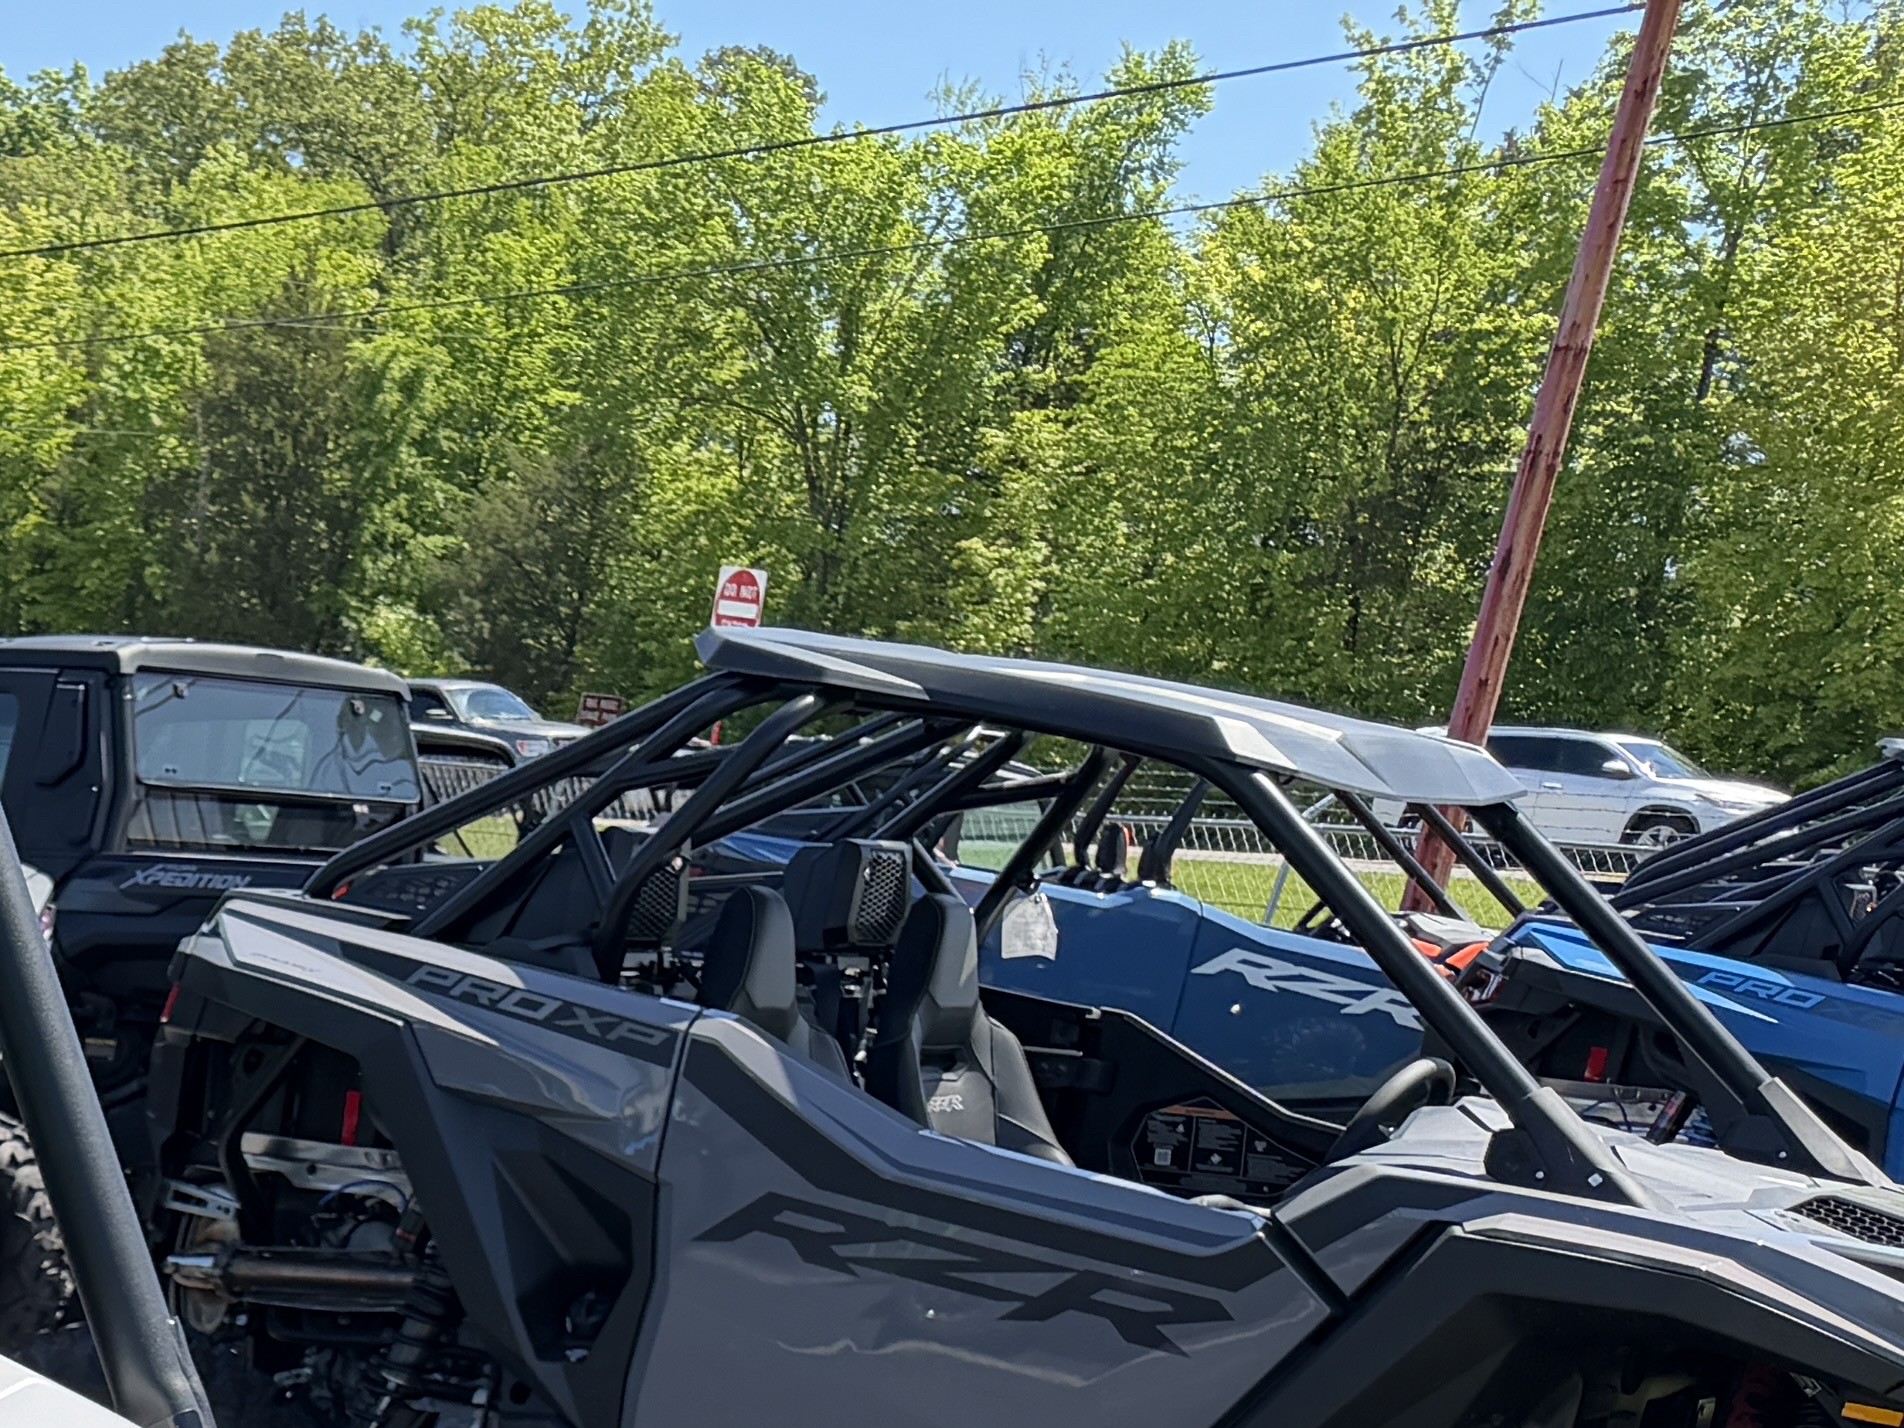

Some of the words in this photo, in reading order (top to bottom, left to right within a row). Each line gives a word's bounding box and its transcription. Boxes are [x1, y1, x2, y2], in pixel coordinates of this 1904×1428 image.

[405, 965, 564, 1020] PRO
[553, 1006, 671, 1047] XP
[1190, 948, 1425, 1032] RZR
[1696, 971, 1827, 1010] PRO
[692, 1191, 1235, 1358] RZR
